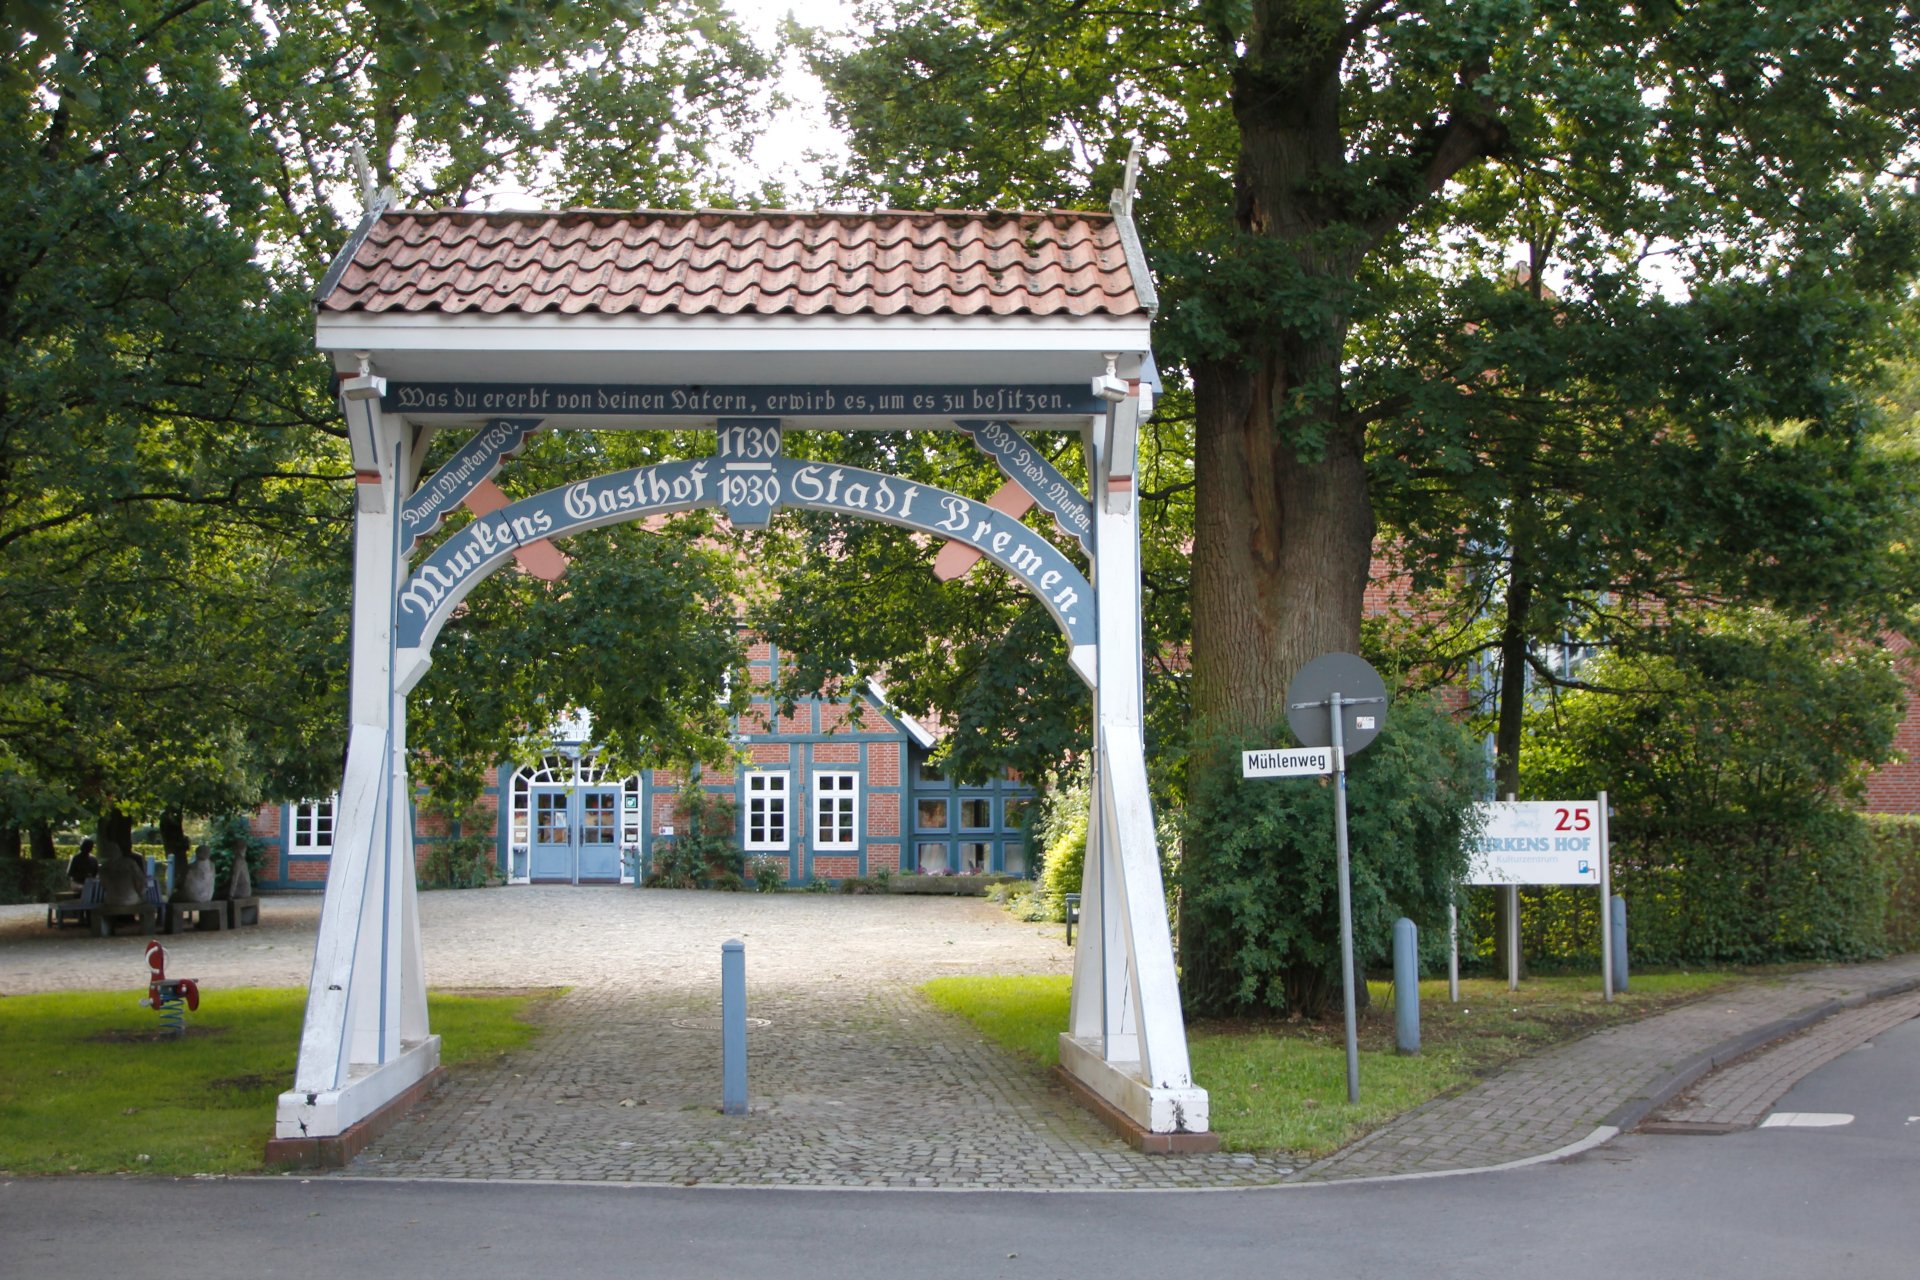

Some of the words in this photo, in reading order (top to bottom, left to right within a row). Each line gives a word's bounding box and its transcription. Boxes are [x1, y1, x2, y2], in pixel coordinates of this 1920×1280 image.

[398, 387, 448, 408] Was
[454, 388, 477, 408] du
[483, 388, 551, 408] ererbt
[557, 391, 592, 409] von
[598, 389, 664, 410] deinen
[767, 390, 836, 410] erwirb
[913, 394, 935, 410] es
[943, 394, 965, 412] zu
[717, 426, 780, 458] 1730
[402, 487, 446, 528] Daniel
[439, 448, 488, 494] Murken
[716, 475, 781, 507] 1930
[981, 421, 1017, 454] 1930
[1011, 448, 1048, 489] Diedr.
[1046, 482, 1091, 534] Murken.
[401, 508, 552, 621] Murkens
[563, 460, 709, 519] Gasthof
[791, 465, 919, 518] Stadt
[935, 496, 1080, 625] Bremen.
[1248, 753, 1326, 770] Mühlenweg
[1554, 808, 1591, 831] 25
[1555, 837, 1591, 852] HOF
[1496, 855, 1559, 864] Kulturzentrum
